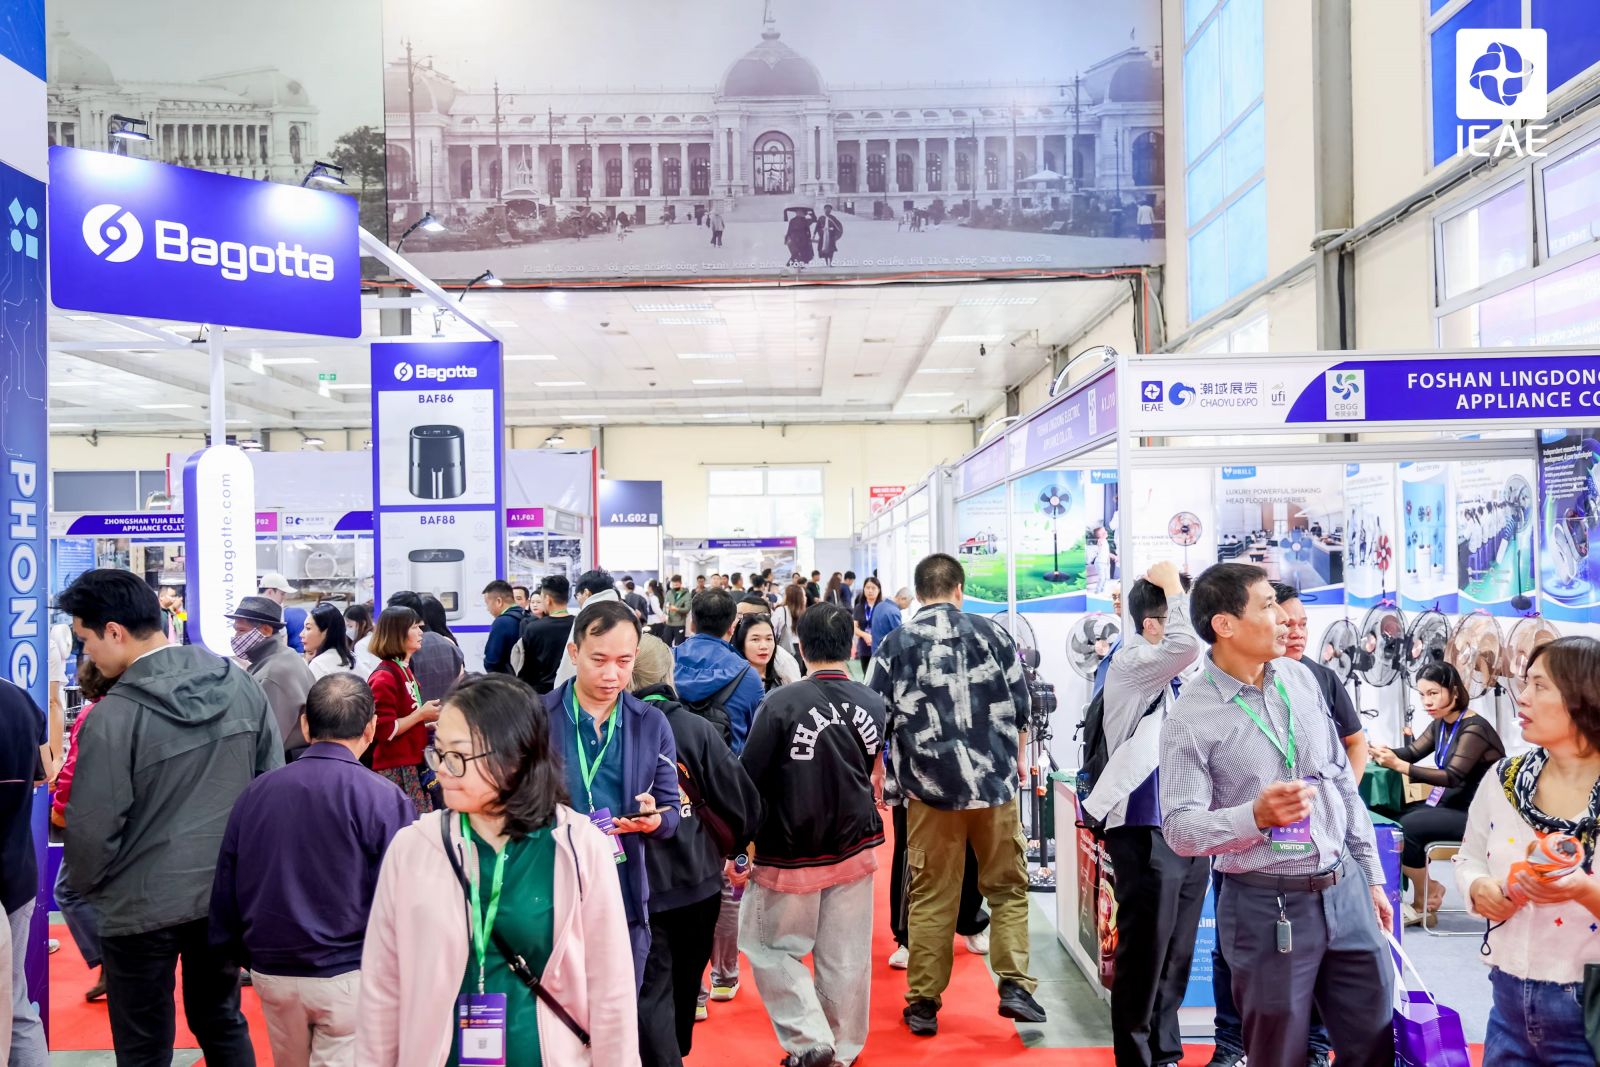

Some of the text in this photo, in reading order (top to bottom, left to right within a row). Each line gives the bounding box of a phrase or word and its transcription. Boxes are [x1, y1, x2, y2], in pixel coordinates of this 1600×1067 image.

[155, 220, 334, 282] Bagotte
[415, 364, 478, 382] Bagotte
[1407, 369, 1600, 389] FOSHAN LINGDON
[418, 394, 454, 404] BAF86
[1271, 388, 1286, 402] ufi
[1200, 398, 1258, 408] CHAOYU EXPO
[1456, 391, 1572, 410] APPLIANCE
[1141, 404, 1164, 412] IEAE
[1334, 403, 1358, 411] CBGG
[150, 517, 167, 525] YIJIA
[420, 515, 456, 525] BAF88
[610, 513, 648, 523] A1.G02
[221, 473, 237, 628] www.bagotte.com
[9, 459, 38, 691] PHONG
[1279, 843, 1305, 851] VISITOR
